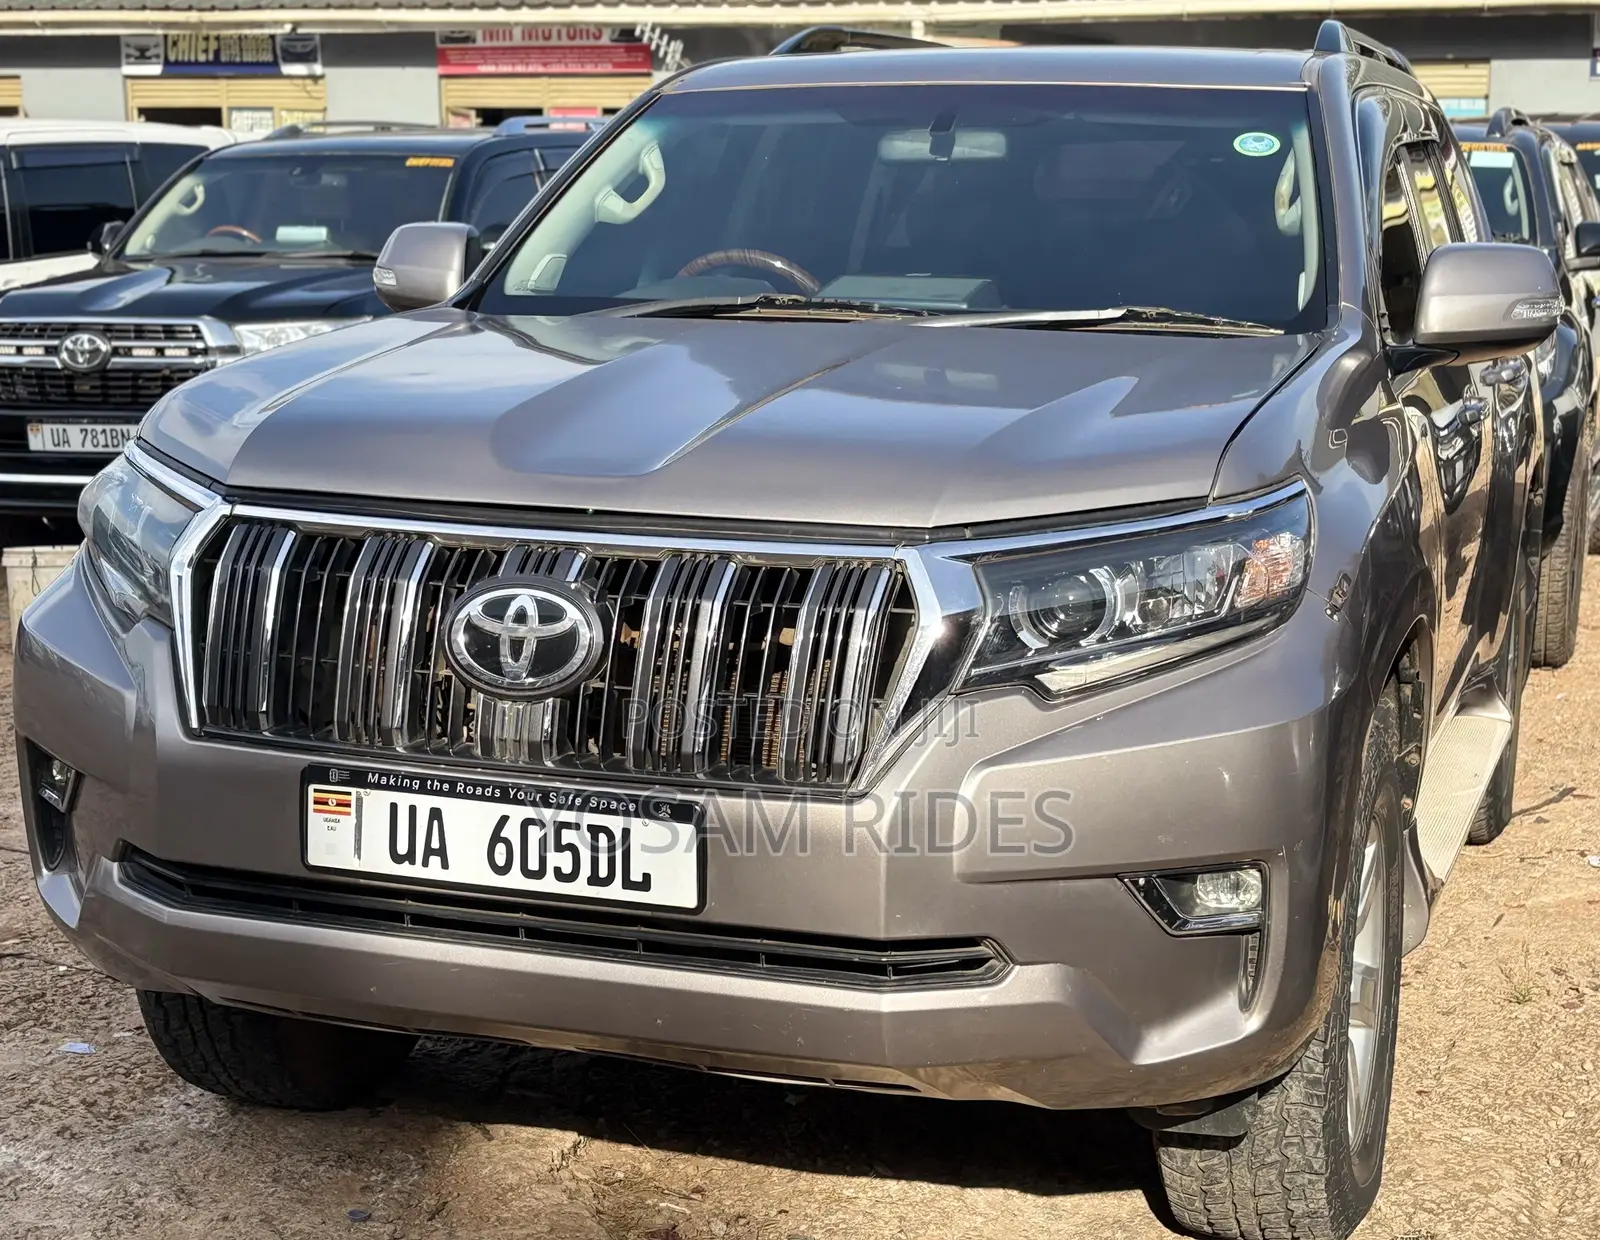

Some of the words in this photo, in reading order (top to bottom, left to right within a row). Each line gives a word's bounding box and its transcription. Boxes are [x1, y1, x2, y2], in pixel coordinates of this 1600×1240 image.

[167, 32, 219, 62] CHIEF
[50, 427, 71, 448] UA
[80, 428, 131, 449] 781BN
[367, 772, 420, 791] Making
[426, 779, 450, 792] the
[456, 782, 501, 798] Roads
[508, 787, 543, 802] Your
[549, 791, 582, 806] Safe
[589, 796, 637, 811] Space
[388, 801, 450, 870] UA
[487, 814, 651, 892] 605DL
